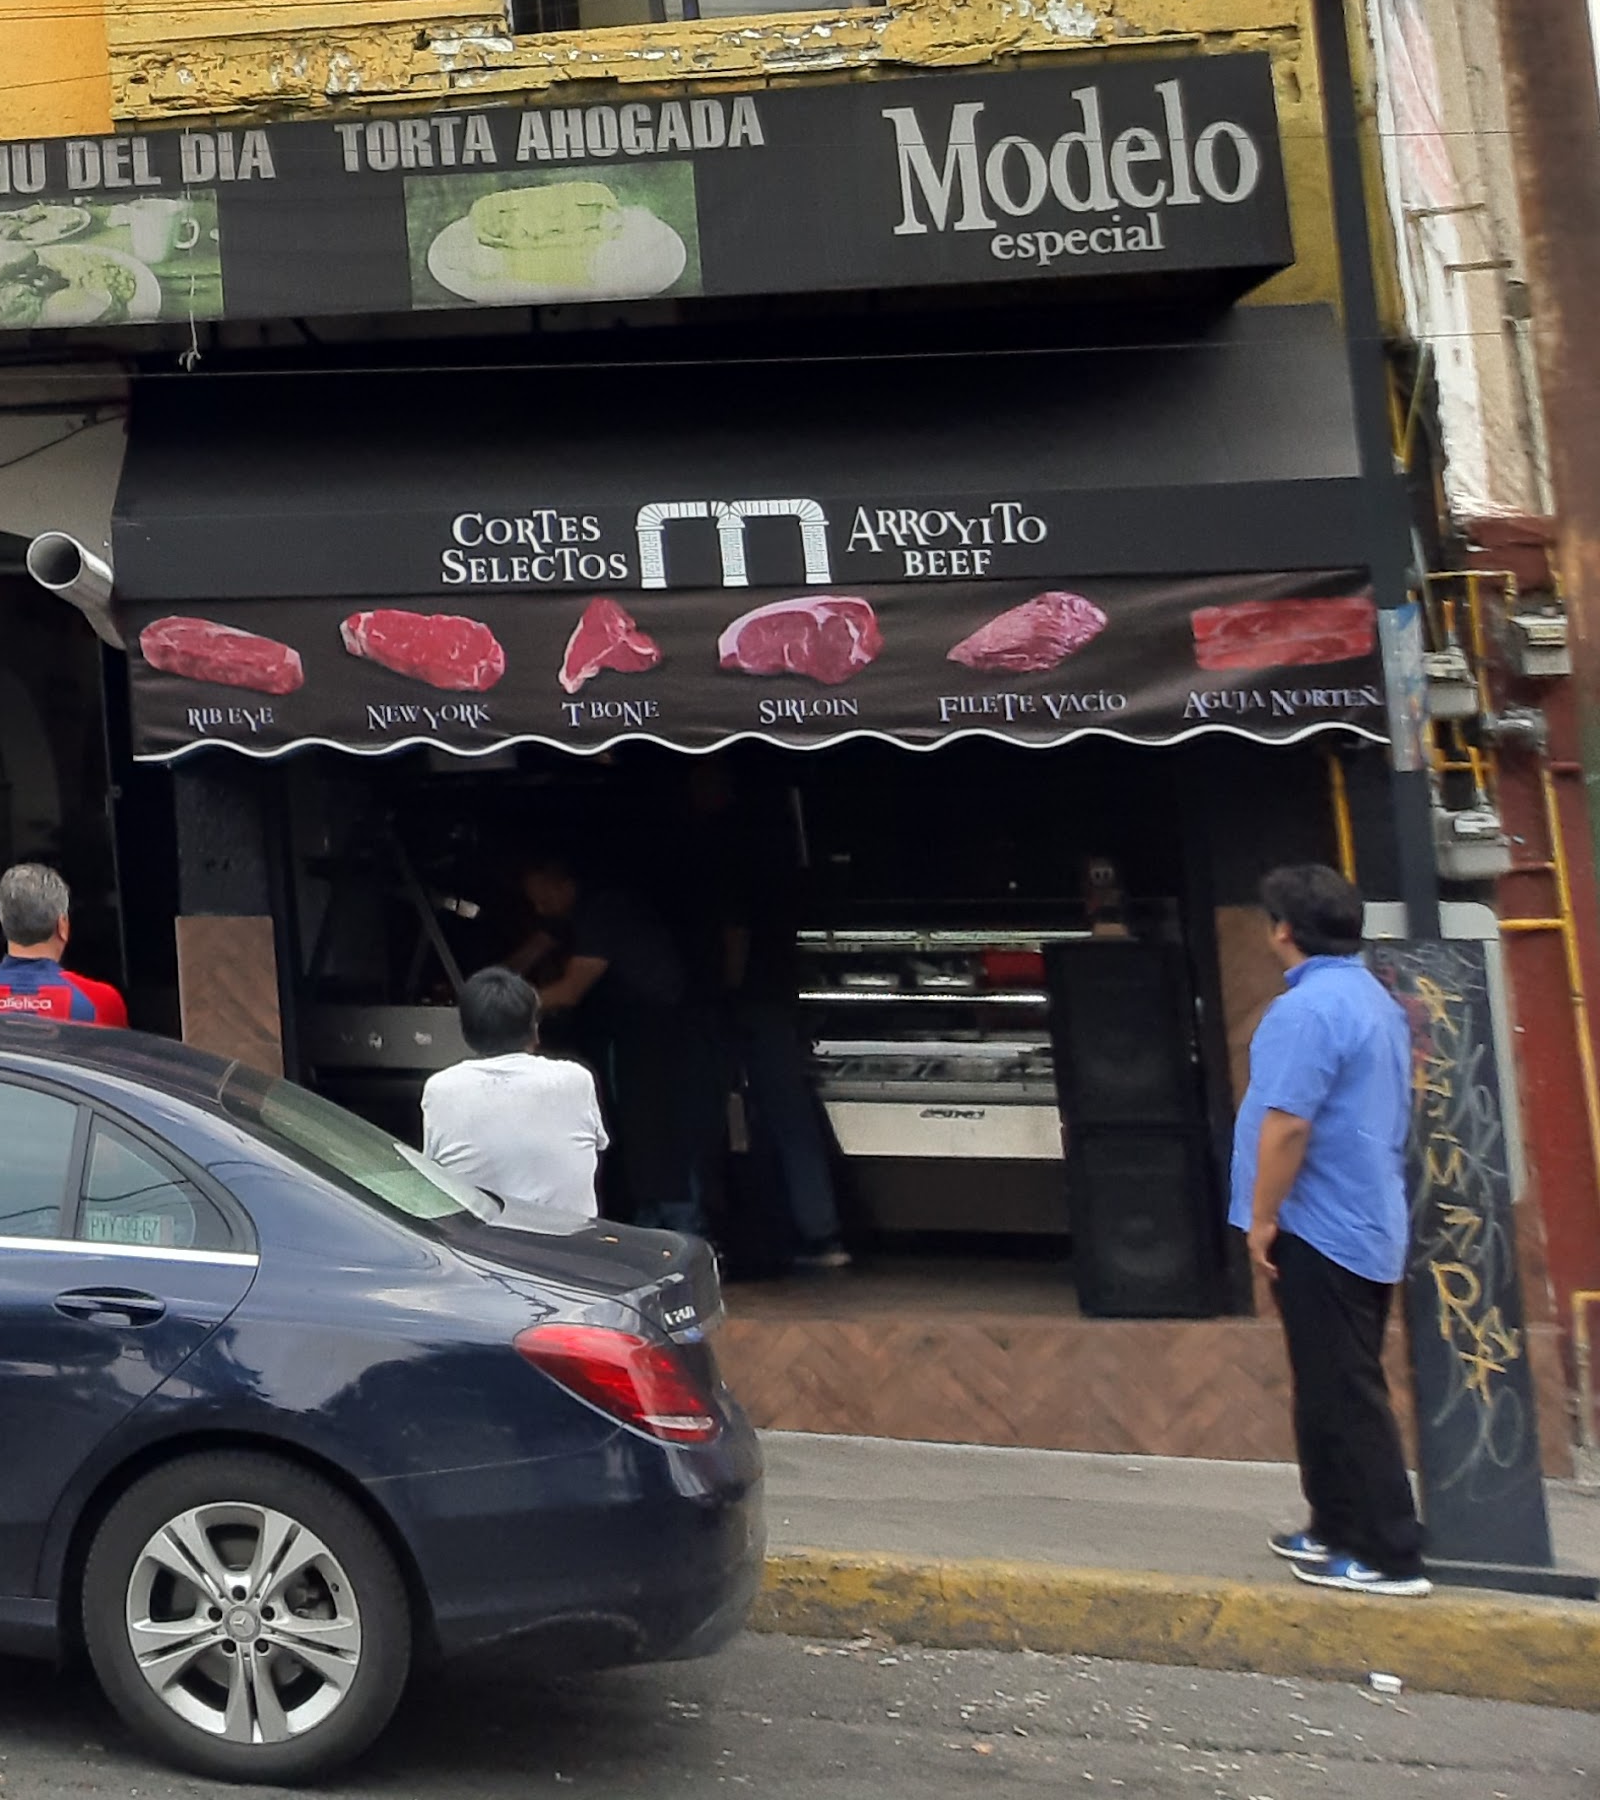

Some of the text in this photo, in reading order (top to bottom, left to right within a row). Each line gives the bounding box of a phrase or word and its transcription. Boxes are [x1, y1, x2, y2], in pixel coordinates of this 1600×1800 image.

[335, 96, 768, 174] TORTA AHOGADA
[66, 137, 162, 190] DEL
[182, 128, 276, 184] DIA
[882, 81, 1260, 238] Modelo
[990, 213, 1166, 266] especial
[903, 550, 993, 577] BEEF
[188, 707, 274, 733] RIB EYE
[366, 703, 492, 731] NEW YORK
[561, 700, 660, 727] T BONE
[759, 698, 858, 724] SIRLOIN
